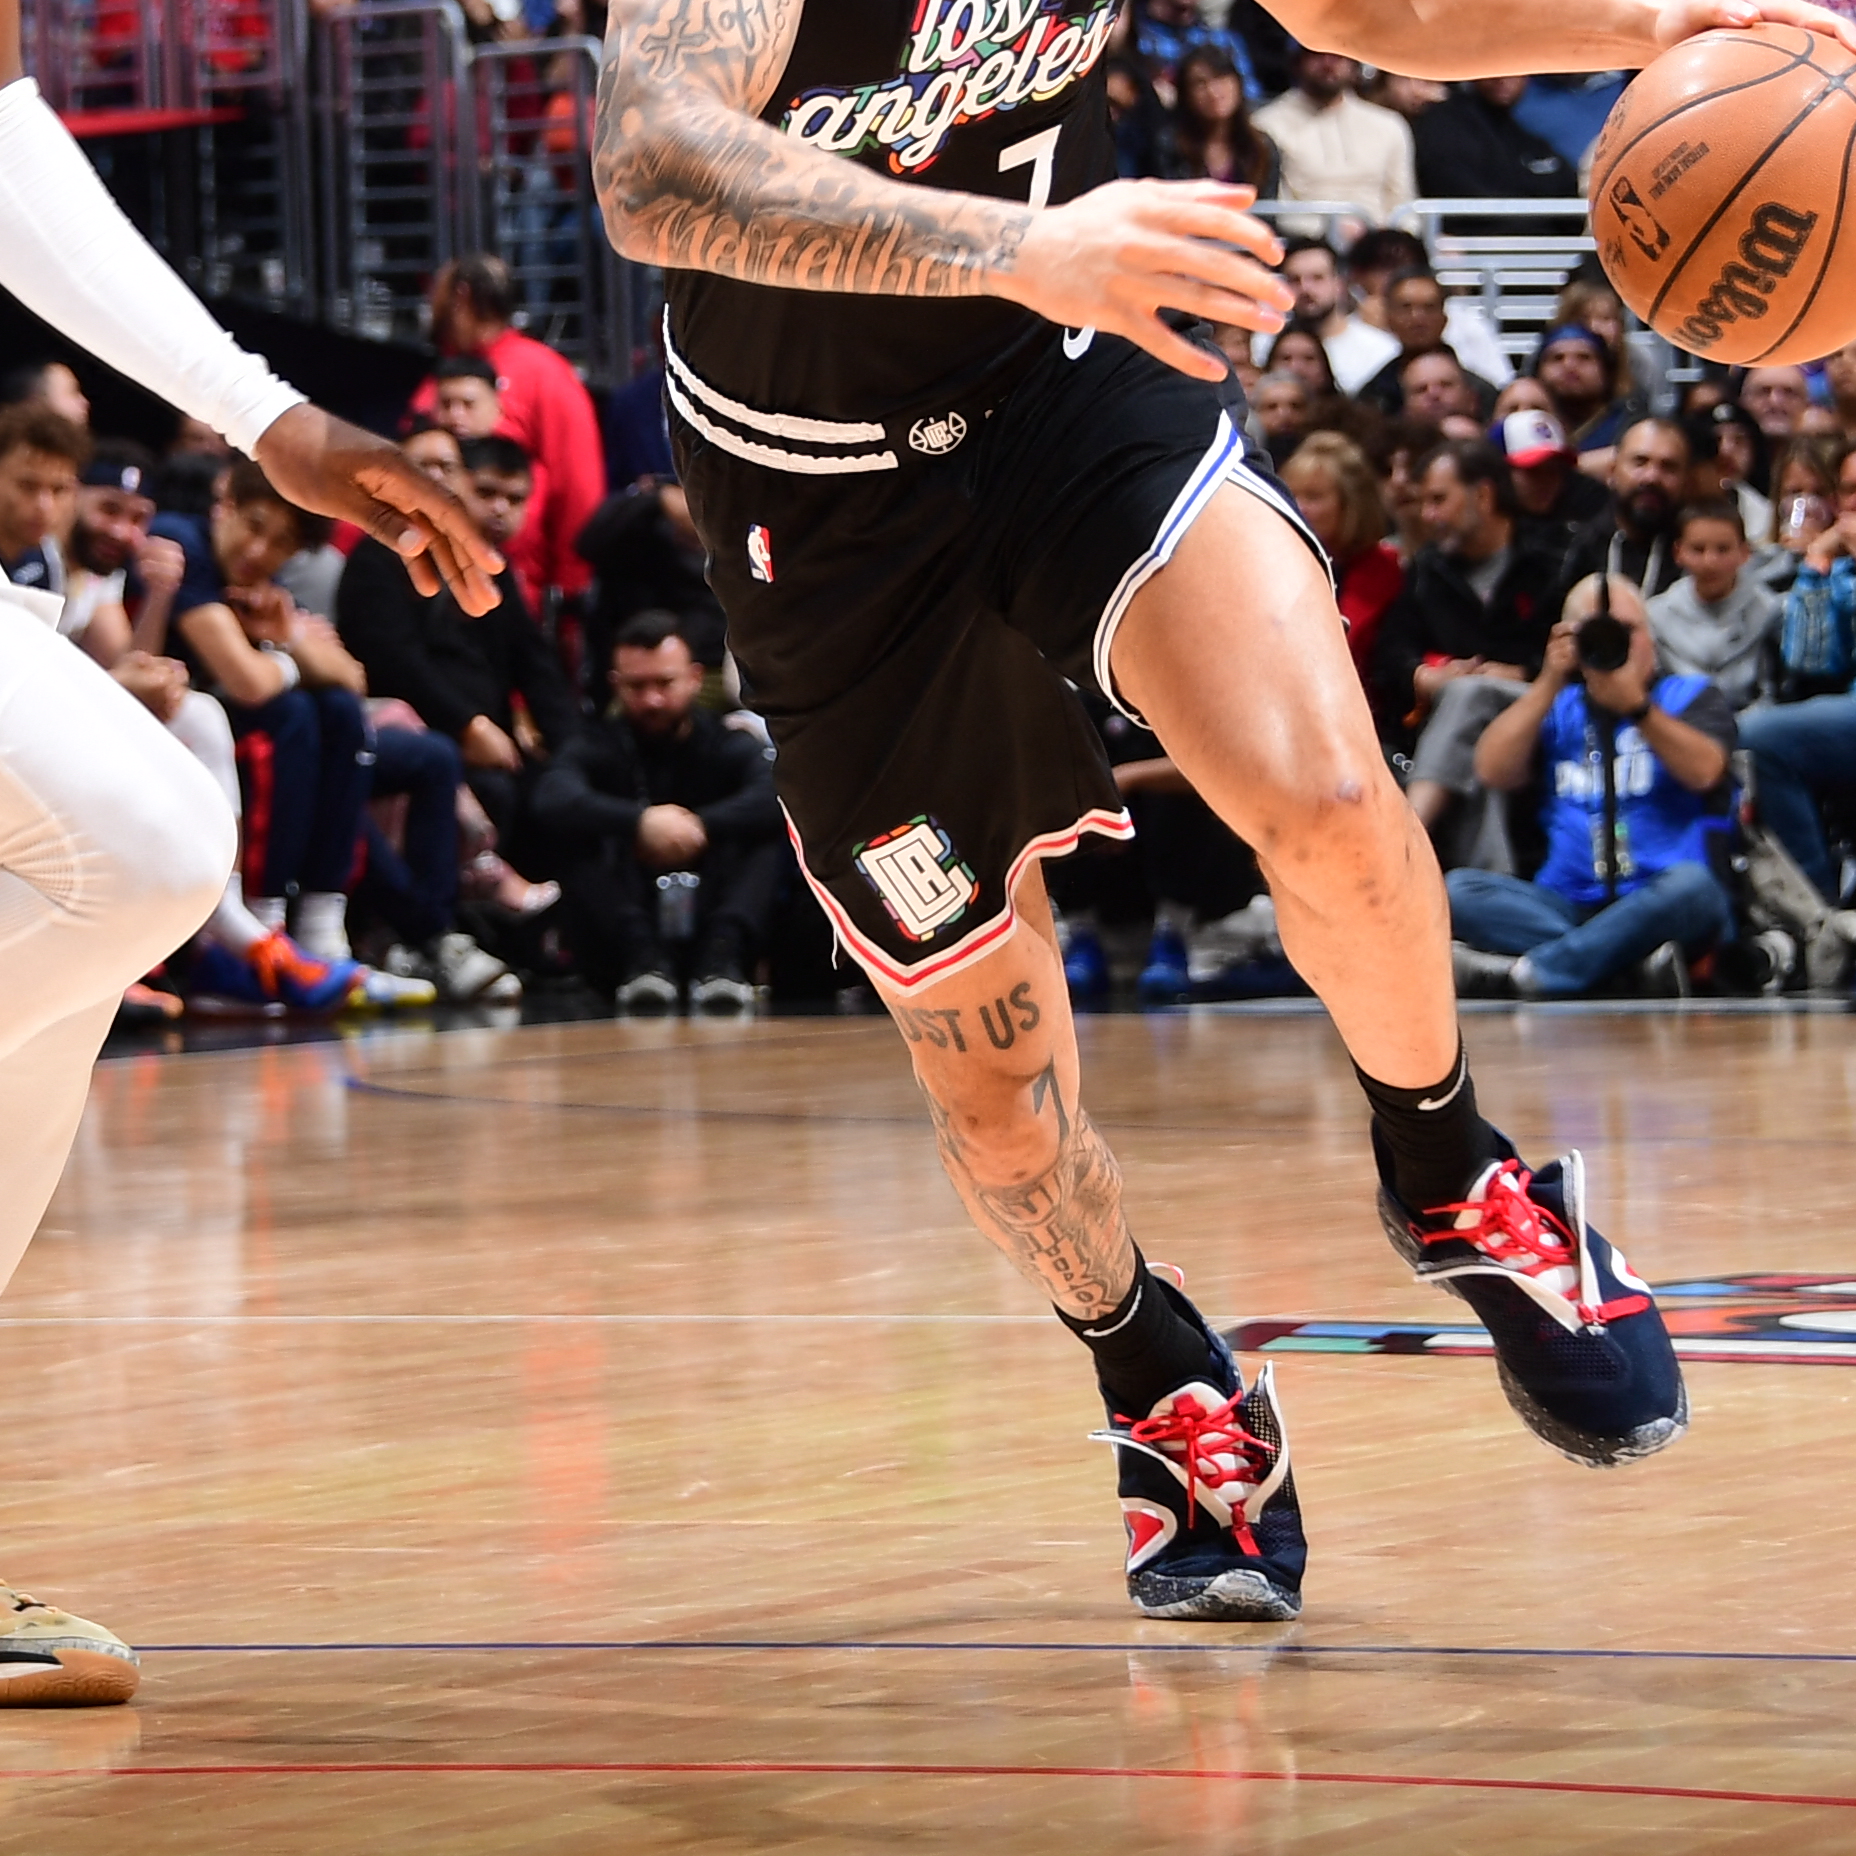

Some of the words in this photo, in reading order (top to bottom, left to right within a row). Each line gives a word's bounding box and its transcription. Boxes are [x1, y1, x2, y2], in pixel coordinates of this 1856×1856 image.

[786, 7, 1117, 168] angeles
[998, 123, 1063, 209] 7
[1672, 201, 1818, 350] Wilson
[892, 1002, 967, 1052] UST
[979, 982, 1041, 1050] US
